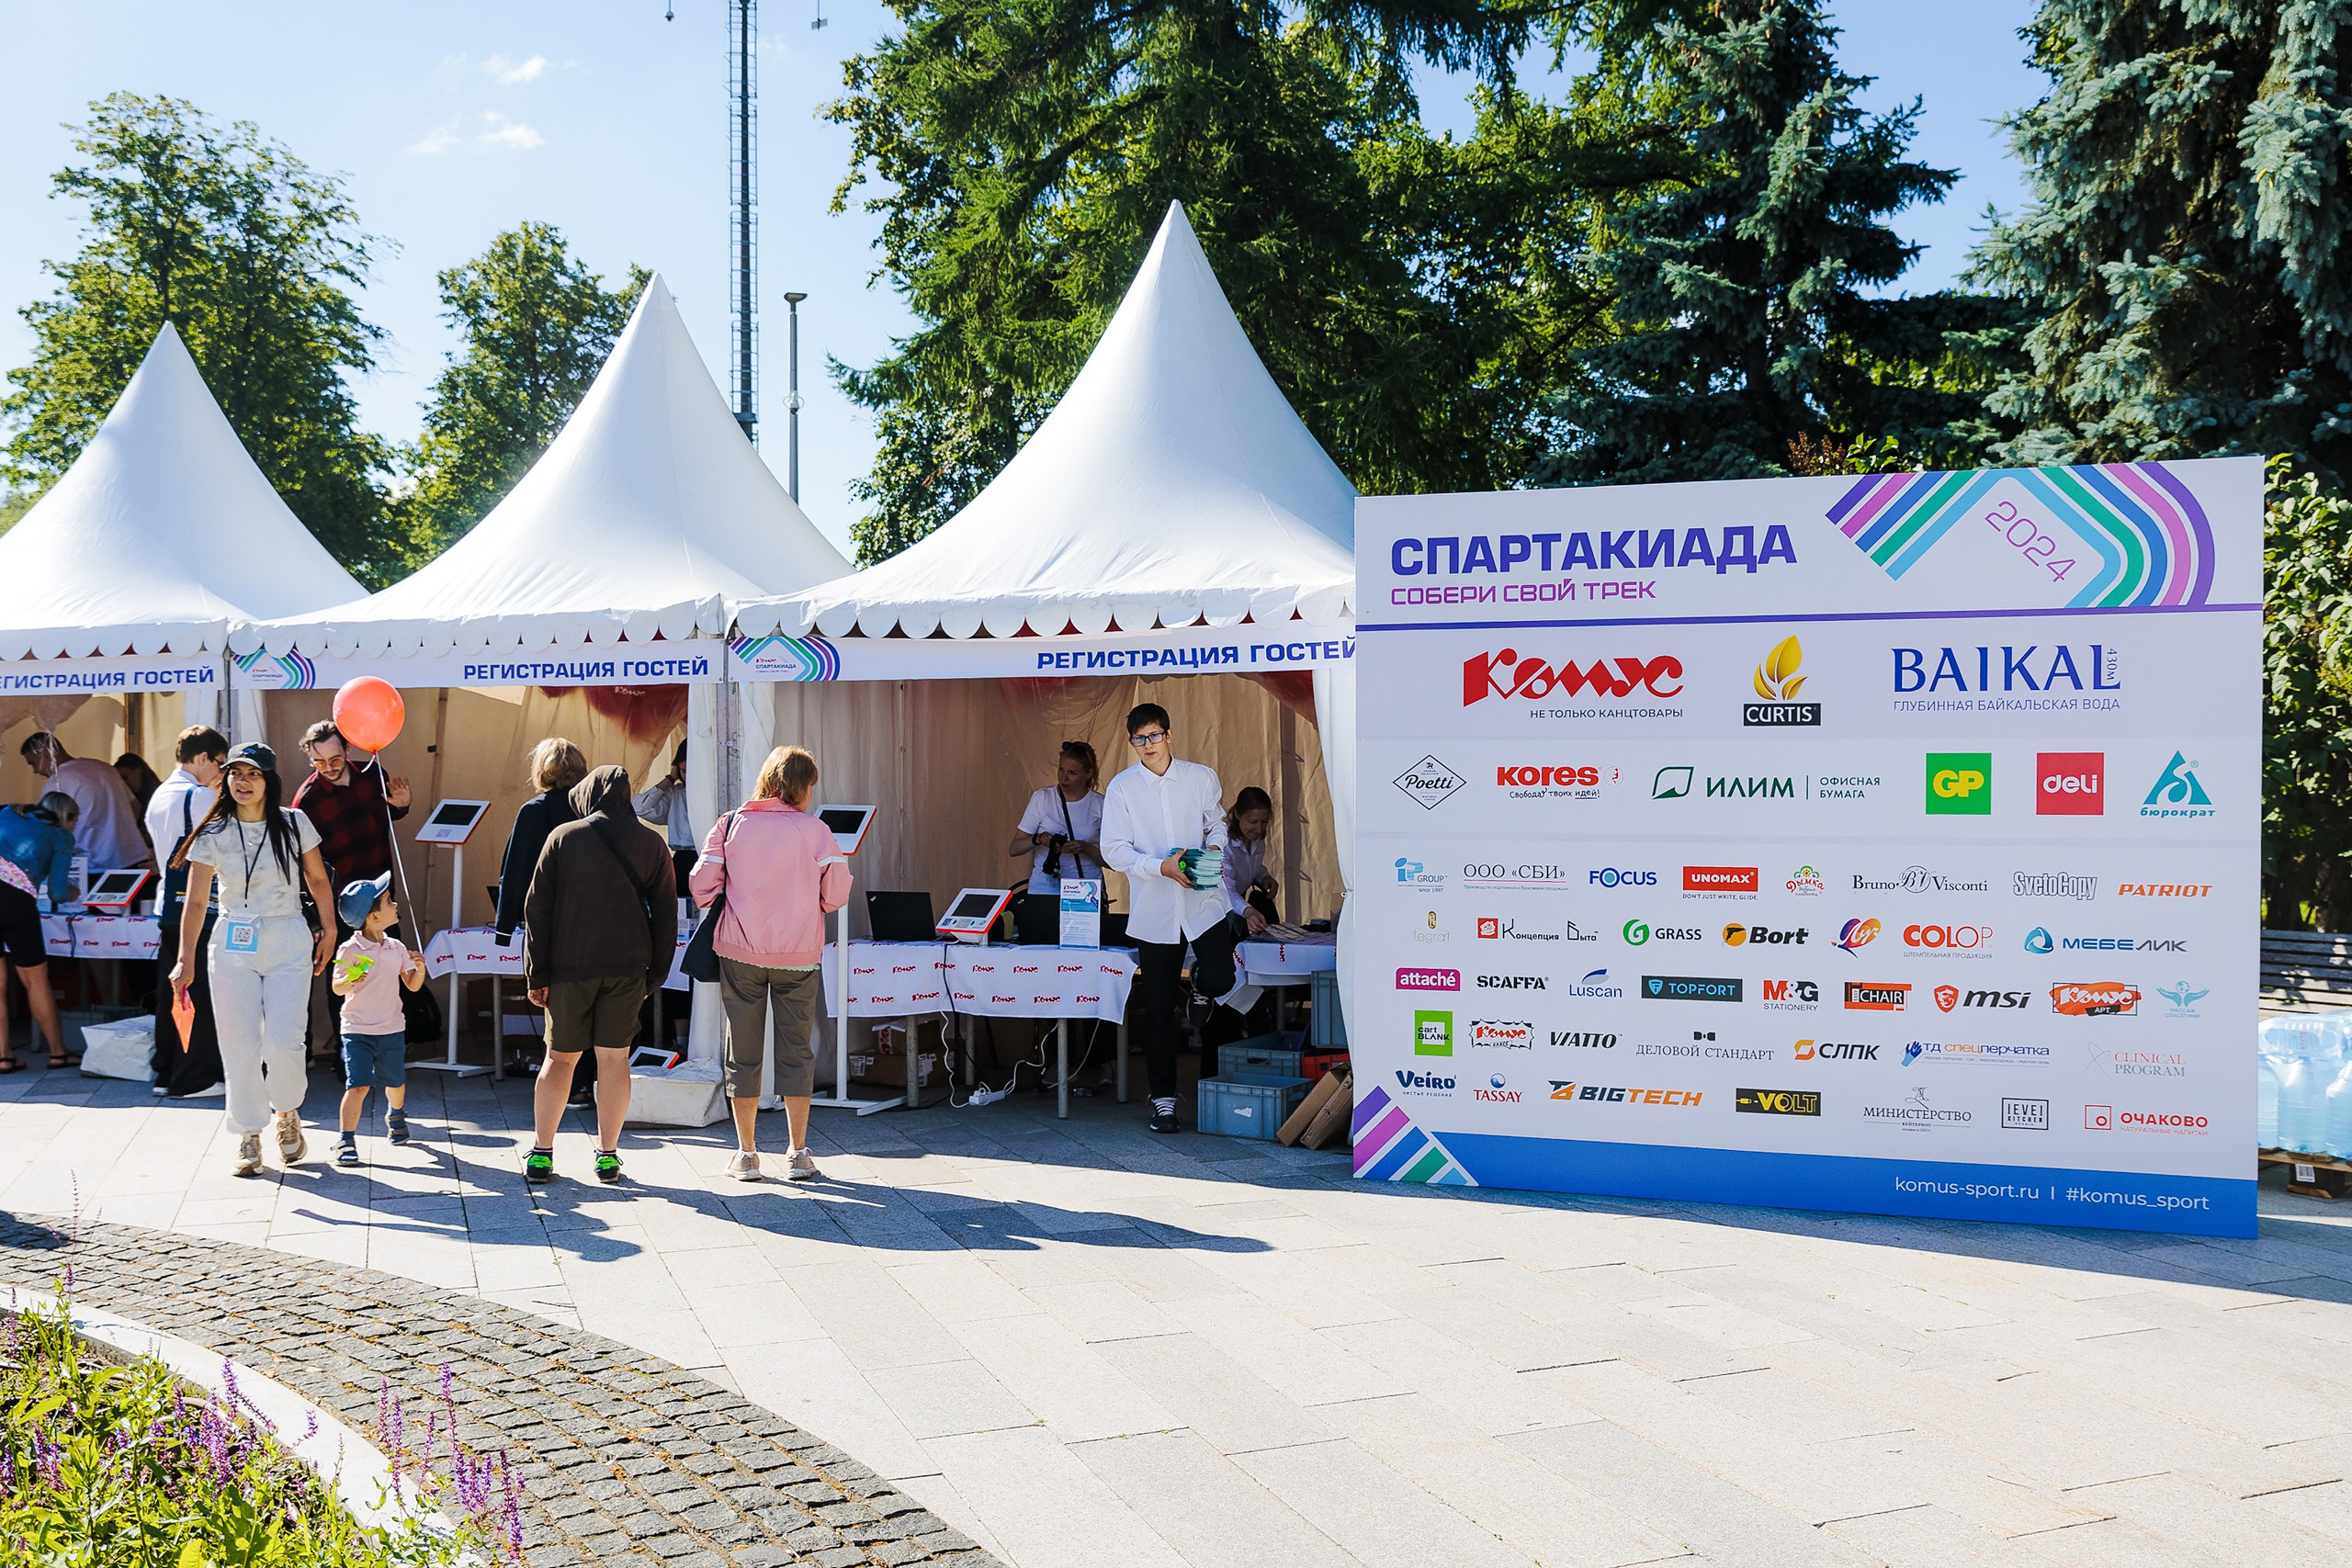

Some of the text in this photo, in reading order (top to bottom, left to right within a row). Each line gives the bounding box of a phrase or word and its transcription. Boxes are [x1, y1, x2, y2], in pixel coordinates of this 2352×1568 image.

[1391, 525, 1797, 575] СПАРТАКИАДА
[1984, 501, 2076, 582] 2024
[1391, 578, 1657, 605] СОБЕРИ СВОЙ ТРЕК
[1036, 636, 1355, 669] РЕГИСТРАЦИЯ ГОСТЕЙ
[0, 665, 214, 689] ГИСТРАЦИЯ ГОСТЕЙ
[464, 656, 709, 681] РЕГИСТРАЦИЯ ГОСТЕЙ
[1891, 644, 2120, 693] BAIKAL
[1464, 648, 1684, 707] Комус
[1894, 697, 2120, 712] ГЛУБИННАЯ БАЙКАЛЬСКАЯ ВОДА
[1530, 708, 1683, 720] НЕ ТОЛЬКО КАНЦТОВАРЫ
[1746, 706, 1813, 724] CURTIS
[1405, 774, 1454, 789] Poetti
[1706, 777, 1794, 797] ИЛИМ
[1820, 776, 1880, 786] ОФИСНАЯ
[1933, 770, 1984, 798] GP
[2042, 774, 2098, 794] deli
[1820, 789, 1865, 798] БУМАГА
[2140, 807, 2215, 818] бюрократ
[1417, 874, 1444, 883] GROUP
[1464, 863, 1566, 879] ООО «СБИ»
[1589, 867, 1657, 888] FOCUS
[1690, 874, 1750, 885] UNOMAX
[1852, 874, 1896, 890] Bruno
[1931, 875, 1988, 892] Visconti
[2013, 871, 2098, 900] SvetoCopy
[2118, 884, 2213, 897] PATRIOT
[1502, 919, 1560, 942] Концепция
[1655, 928, 1702, 941] GRASS
[1749, 926, 1809, 944] Bort
[1903, 925, 1994, 949] COLOP
[2063, 938, 2188, 953] МЕБЕЛИК
[1399, 972, 1456, 987] attaché
[1476, 976, 1546, 989] SCAFFA
[1569, 985, 1623, 998] Luscan
[1668, 983, 1736, 996] TOPFORT
[1763, 980, 1819, 1001] M&G
[1860, 990, 1903, 1003] CHAIR
[2060, 986, 2132, 1005] Комус
[1476, 1025, 1527, 1040] Комус
[1550, 1032, 1617, 1049] VIATTO
[1636, 1044, 1774, 1061] ДЕЛОВОЙ СТАНДАРТ
[1818, 1043, 1881, 1061] СЛПК
[1923, 1043, 2050, 1055] ТД спецперчатка
[2114, 1052, 2187, 1065] CLINICAL
[2115, 1064, 2186, 1077] PROGRAM
[1473, 1089, 1523, 1103] TASSAY
[1578, 1086, 1703, 1107] BIGTECH
[1757, 1092, 1817, 1112] VOLT
[1863, 1107, 1972, 1122] МИНИСТЕРСТВО
[2120, 1112, 2209, 1128] ОЧАКОВО
[1895, 1176, 2211, 1211] komus-sport.ru #komus_sport
